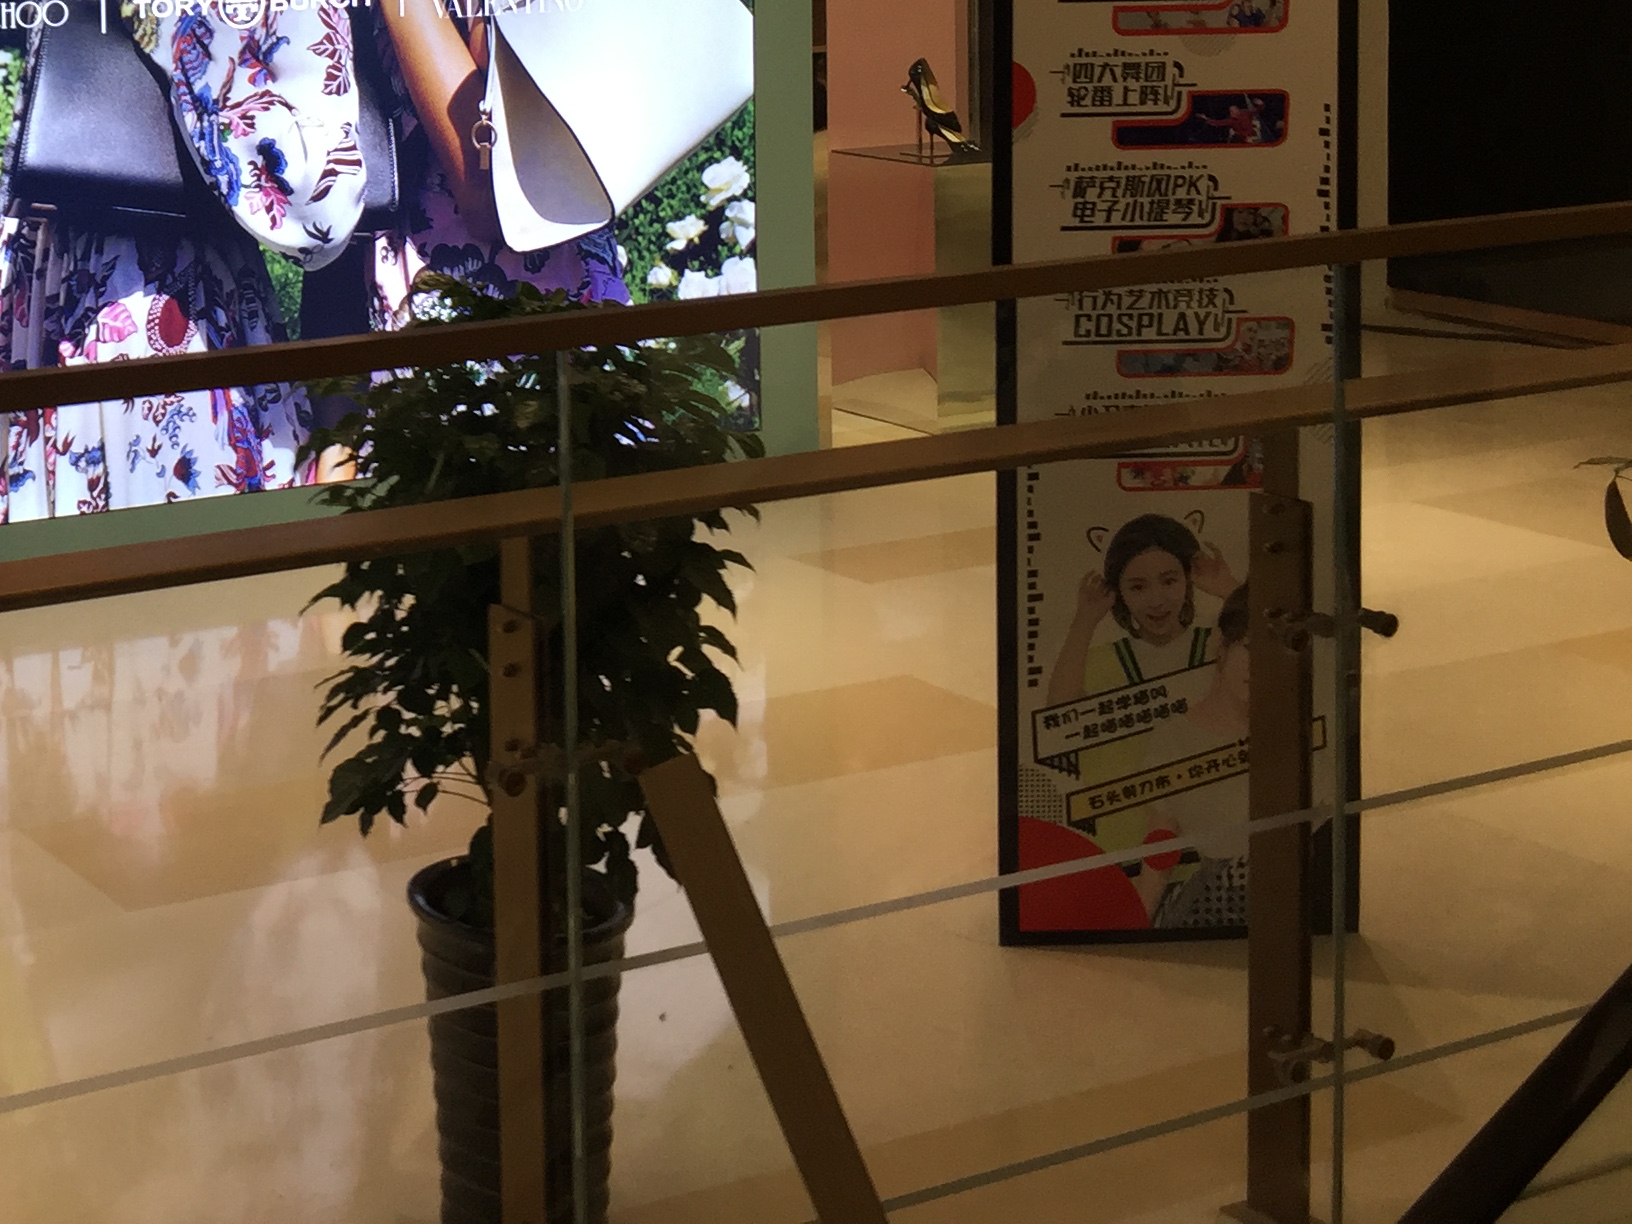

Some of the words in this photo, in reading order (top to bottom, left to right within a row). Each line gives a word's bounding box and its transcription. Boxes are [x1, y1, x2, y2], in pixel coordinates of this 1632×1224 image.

[1072, 61, 1167, 84] 四大舞团
[1067, 84, 1162, 108] 轮番上阵
[1071, 198, 1197, 224] 电子小提琴
[1073, 310, 1211, 338] COSPLAY
